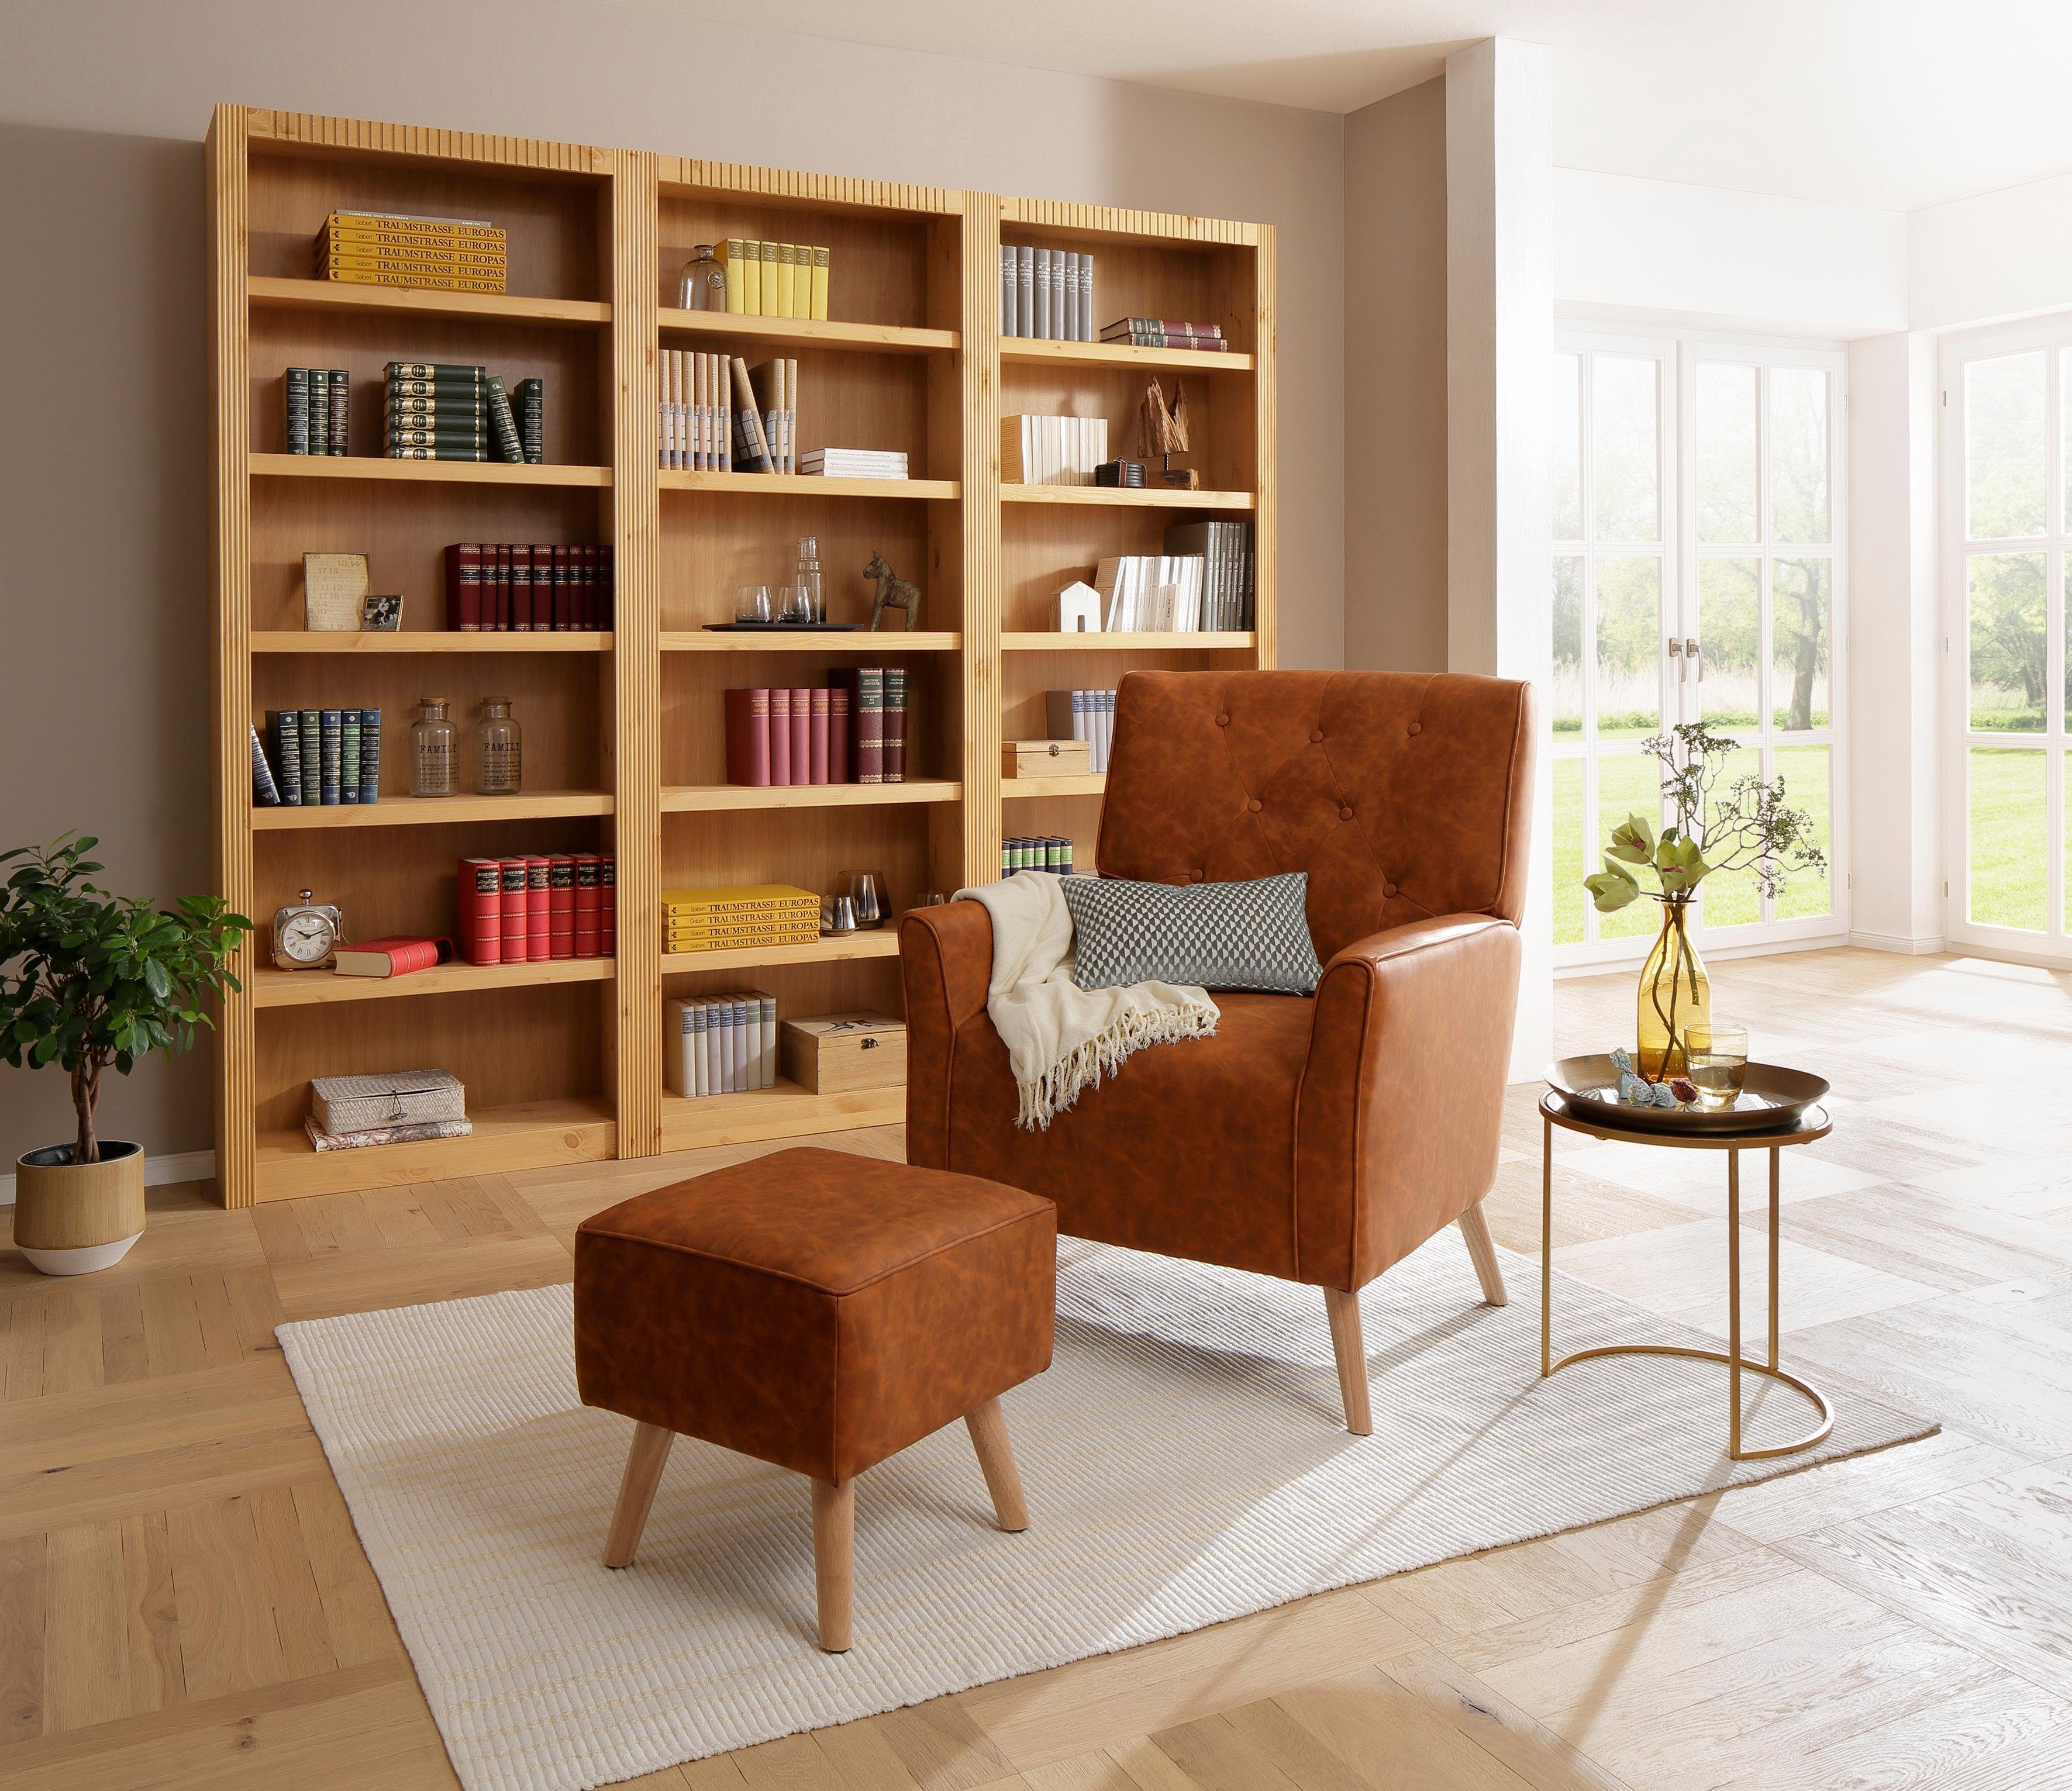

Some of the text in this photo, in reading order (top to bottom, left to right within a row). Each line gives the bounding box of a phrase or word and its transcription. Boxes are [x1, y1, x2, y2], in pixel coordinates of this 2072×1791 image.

[375, 220, 454, 234] TRAUMSTRASSE
[458, 227, 504, 238] EUROPAS
[376, 233, 454, 247] TRAUMSTRASSE
[458, 240, 504, 251] EUROPAS
[377, 247, 455, 261] TRAUMSTRASSE
[458, 254, 505, 265] EUROPAS
[375, 261, 454, 274] TRAUMSTRASSE
[458, 267, 504, 278] EUROPAS
[375, 274, 454, 287] TRAUMSTRASSE
[458, 280, 504, 291] EUROPAS
[484, 743, 520, 751] FAMILY
[708, 900, 776, 912] TRAUMSTRASSE
[779, 898, 819, 907] EUROPAS
[708, 913, 775, 924] TRAUMSTRASSE
[778, 910, 818, 919] EUROPAS
[708, 924, 776, 936] TRAUMSTRASSE
[779, 921, 819, 931] EUROPAS
[708, 936, 775, 948] TRAUMSTRASSE
[778, 933, 818, 943] EUROPAS
